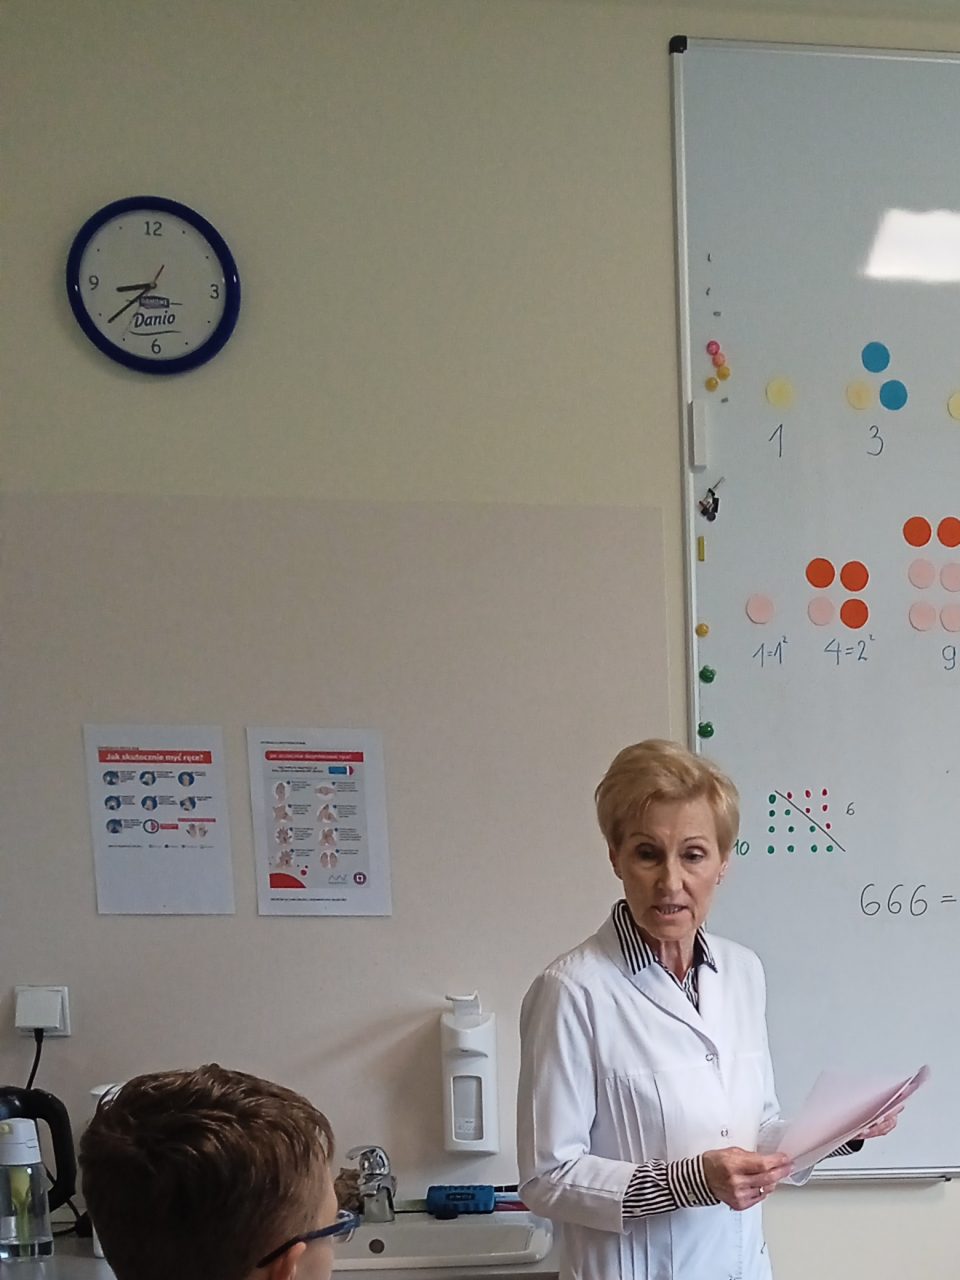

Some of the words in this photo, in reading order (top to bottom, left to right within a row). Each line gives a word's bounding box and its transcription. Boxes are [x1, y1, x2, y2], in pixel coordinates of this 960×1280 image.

[144, 220, 163, 237] 12
[88, 274, 100, 291] 9
[209, 283, 220, 300] 3
[132, 310, 176, 329] Danio
[150, 338, 162, 355] 6
[768, 423, 783, 458] 1
[866, 424, 884, 457] 3
[845, 801, 856, 816] 6
[733, 838, 750, 856] 10
[859, 882, 928, 916] 666
